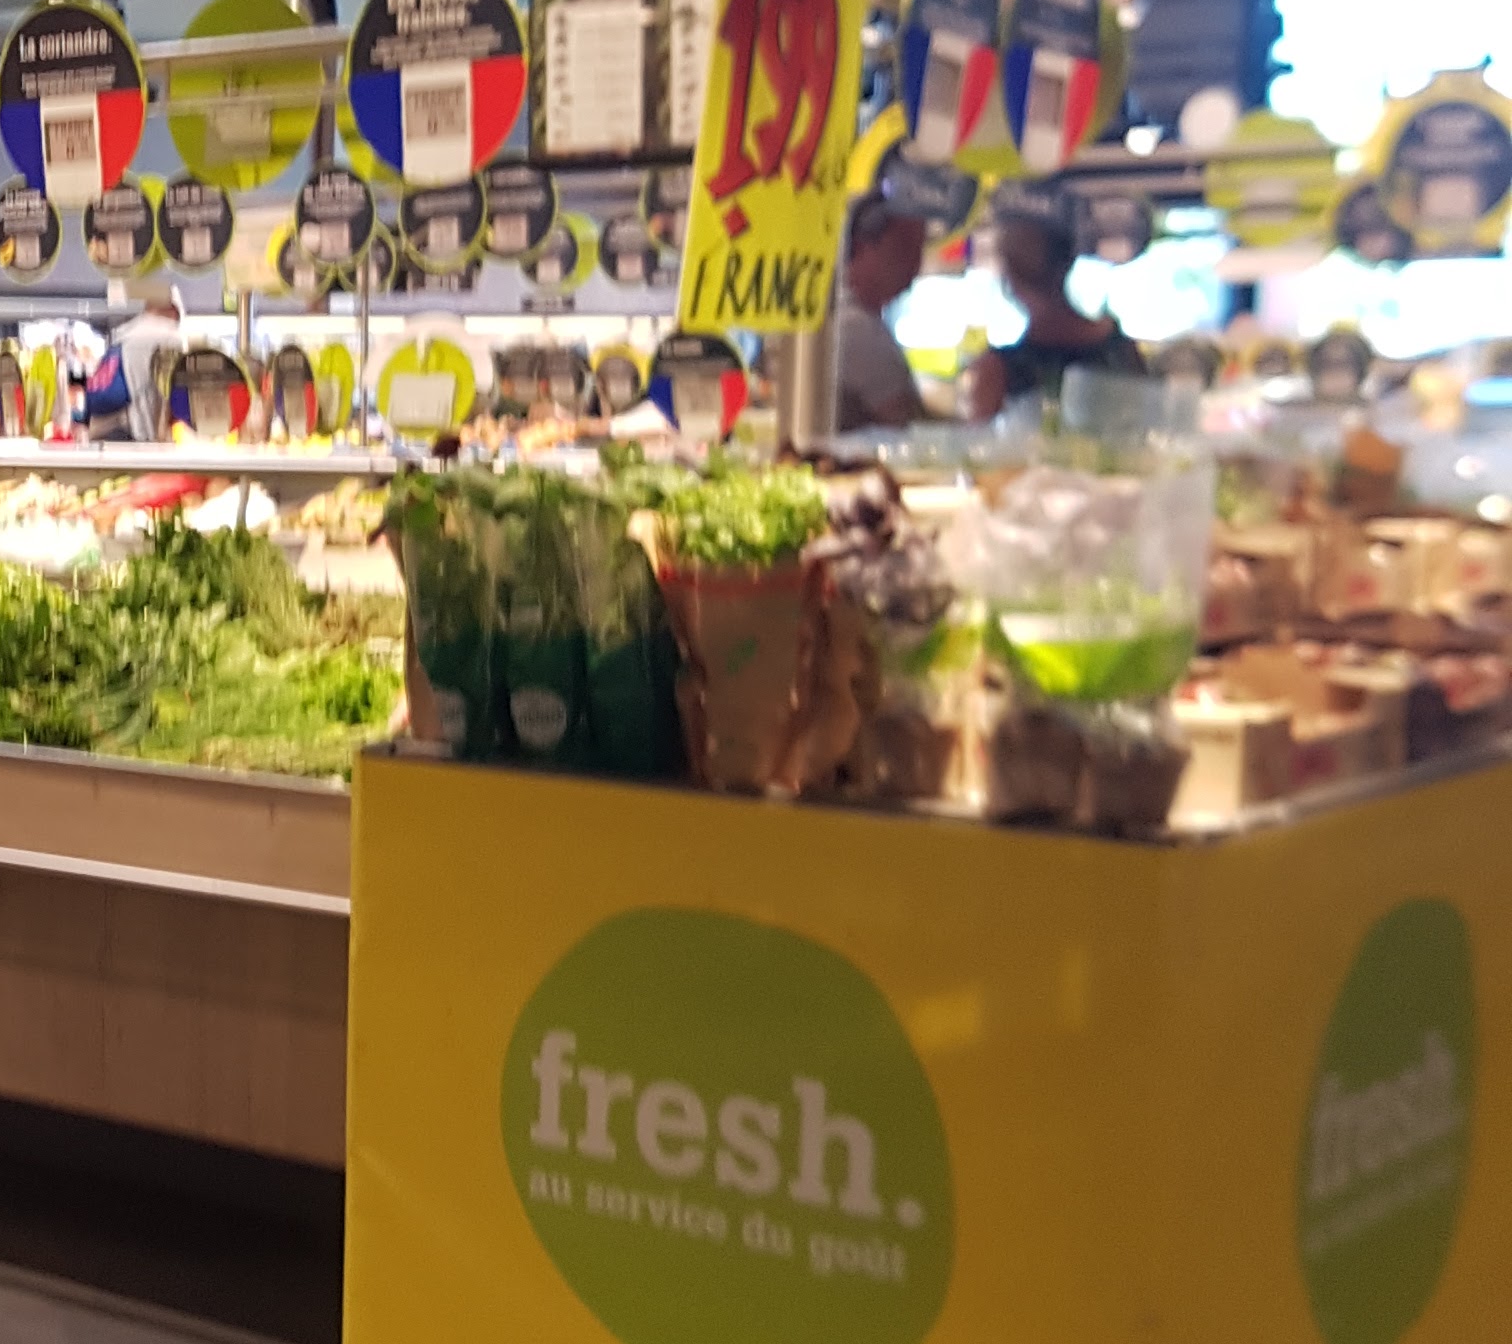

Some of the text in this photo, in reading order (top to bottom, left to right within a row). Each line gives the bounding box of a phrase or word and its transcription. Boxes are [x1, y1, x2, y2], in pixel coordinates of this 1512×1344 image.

[530, 1170, 572, 1206] au
[587, 1180, 728, 1244] service
[742, 1210, 793, 1259] du
